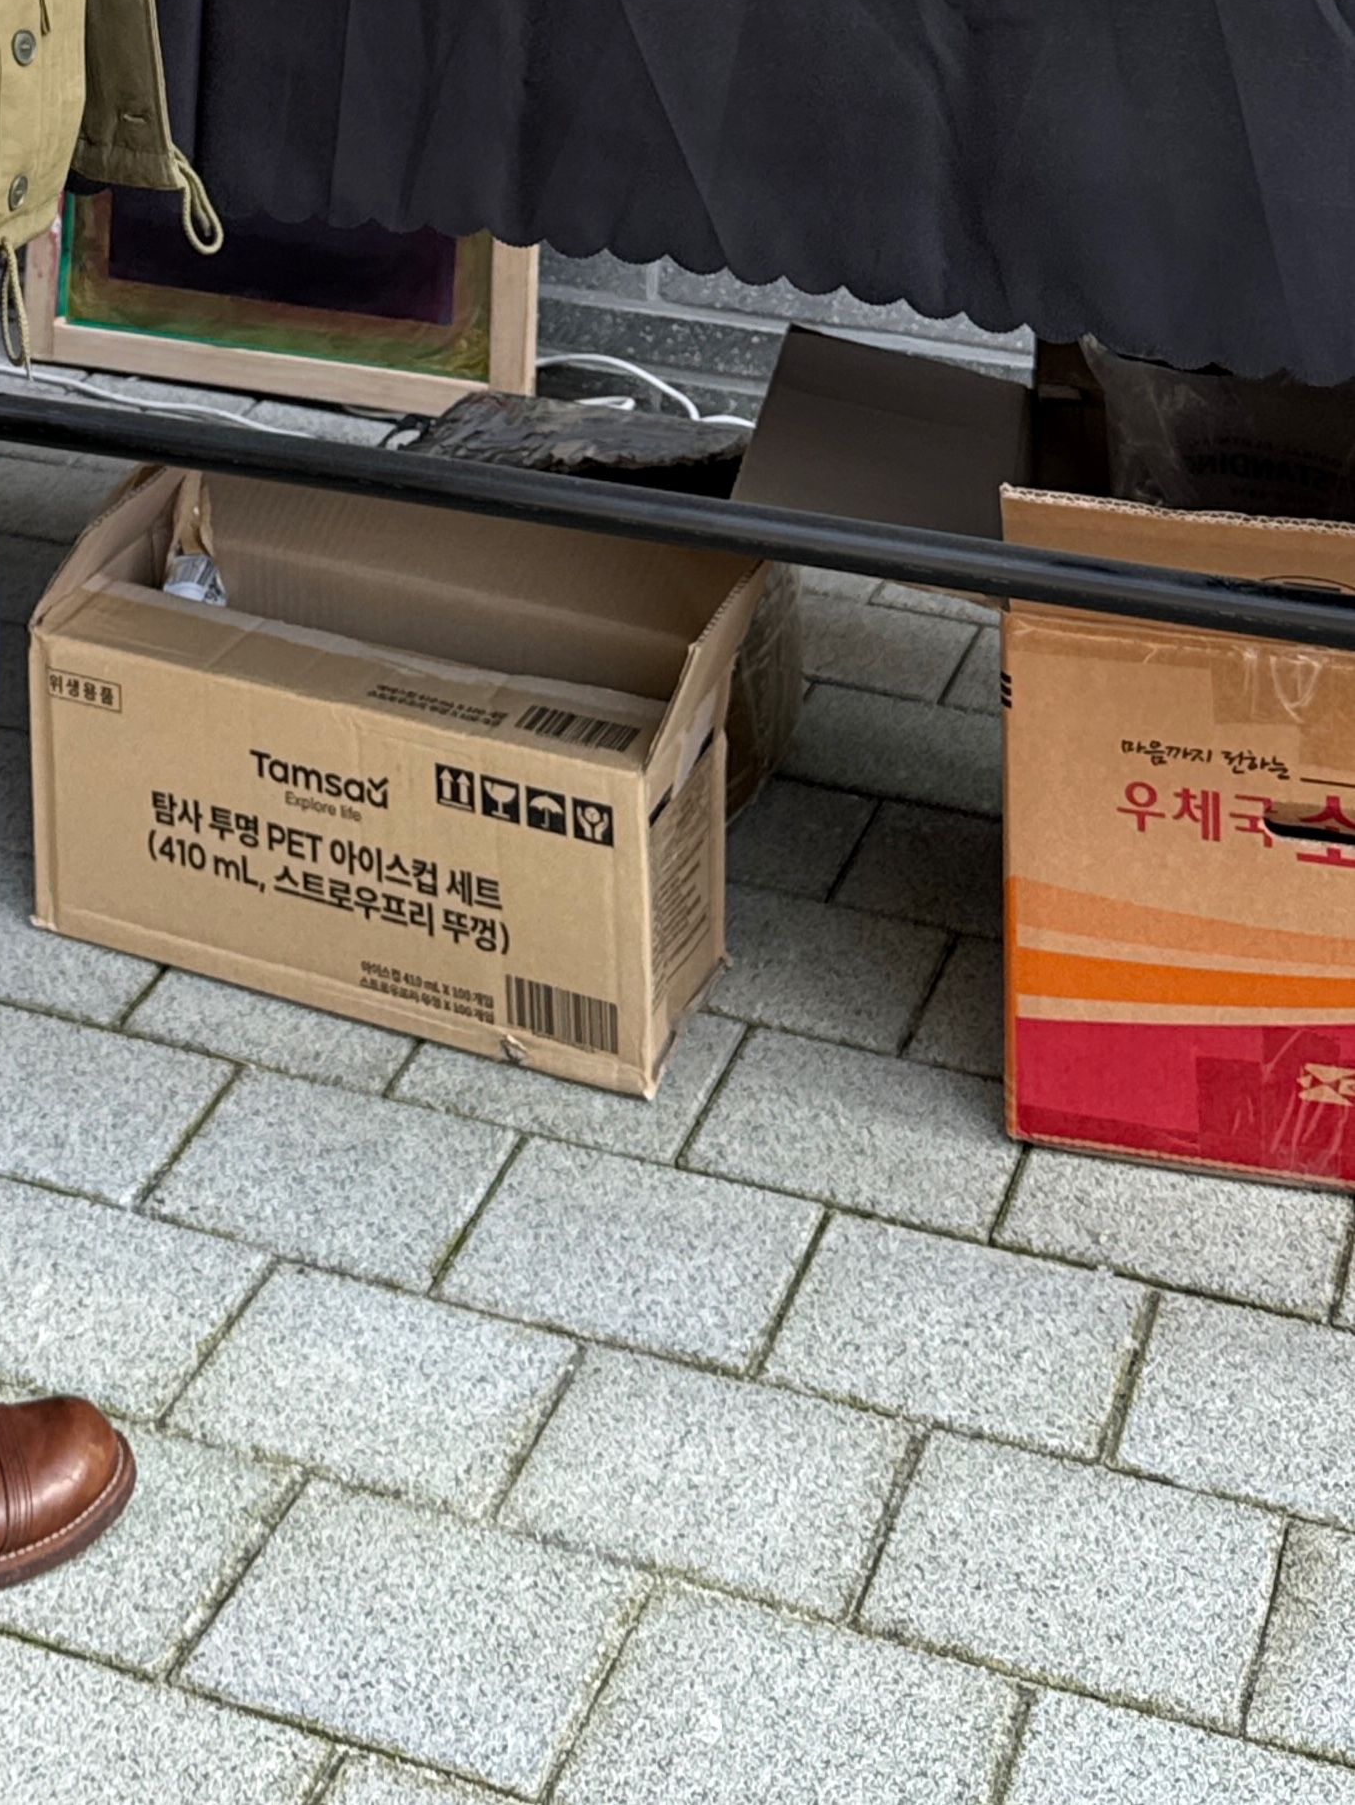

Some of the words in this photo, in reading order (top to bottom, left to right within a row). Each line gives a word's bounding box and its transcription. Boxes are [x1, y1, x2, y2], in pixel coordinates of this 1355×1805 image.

[1121, 739, 1213, 766] 마음까지
[1221, 749, 1291, 780] 전하는
[284, 790, 337, 817] Explore
[340, 804, 362, 823] life
[1116, 780, 1278, 849] 우체국
[151, 790, 203, 834] 탐사
[208, 805, 260, 848] 투명
[266, 821, 323, 863] PET
[329, 838, 439, 898] 아이스컵
[446, 869, 503, 910] 세트
[147, 828, 206, 871] (410
[213, 854, 266, 894] mL,
[273, 865, 434, 938] 스트로우프리
[442, 908, 510, 956] 뚜껑)
